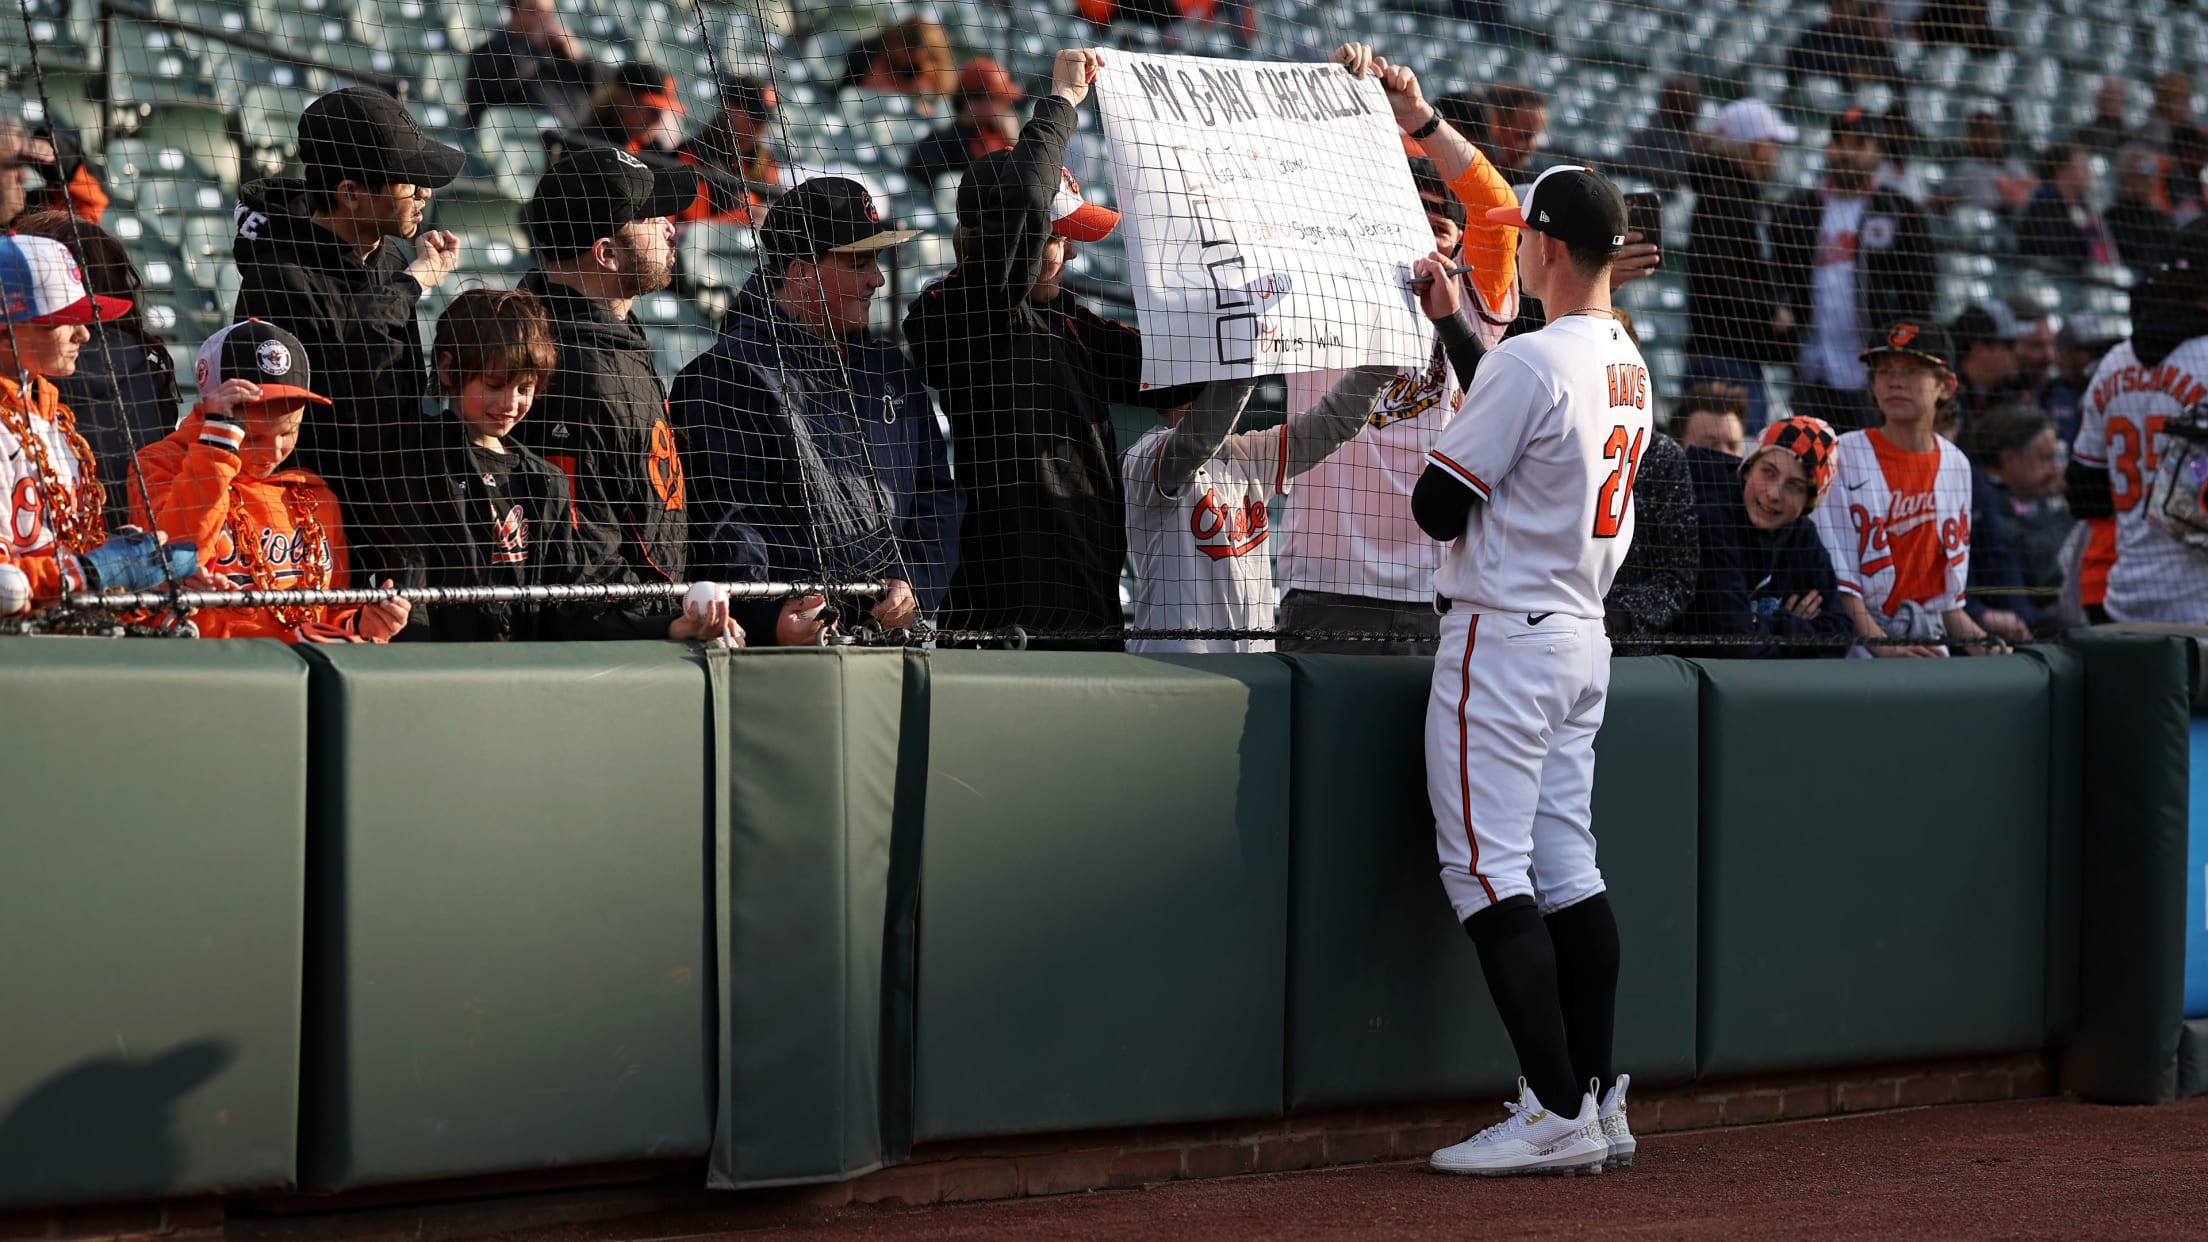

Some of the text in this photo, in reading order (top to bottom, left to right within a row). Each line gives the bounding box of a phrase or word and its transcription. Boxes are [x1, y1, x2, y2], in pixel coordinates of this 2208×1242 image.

[1130, 61, 1188, 123] MY
[1177, 68, 1258, 127] B-DAY
[1326, 225, 1356, 252] my
[1313, 322, 1341, 350] Win
[1606, 363, 1647, 411] HAYS
[2093, 363, 2207, 417] RUTSCHMAN
[1592, 424, 1645, 539] 21
[2105, 415, 2168, 513] 35
